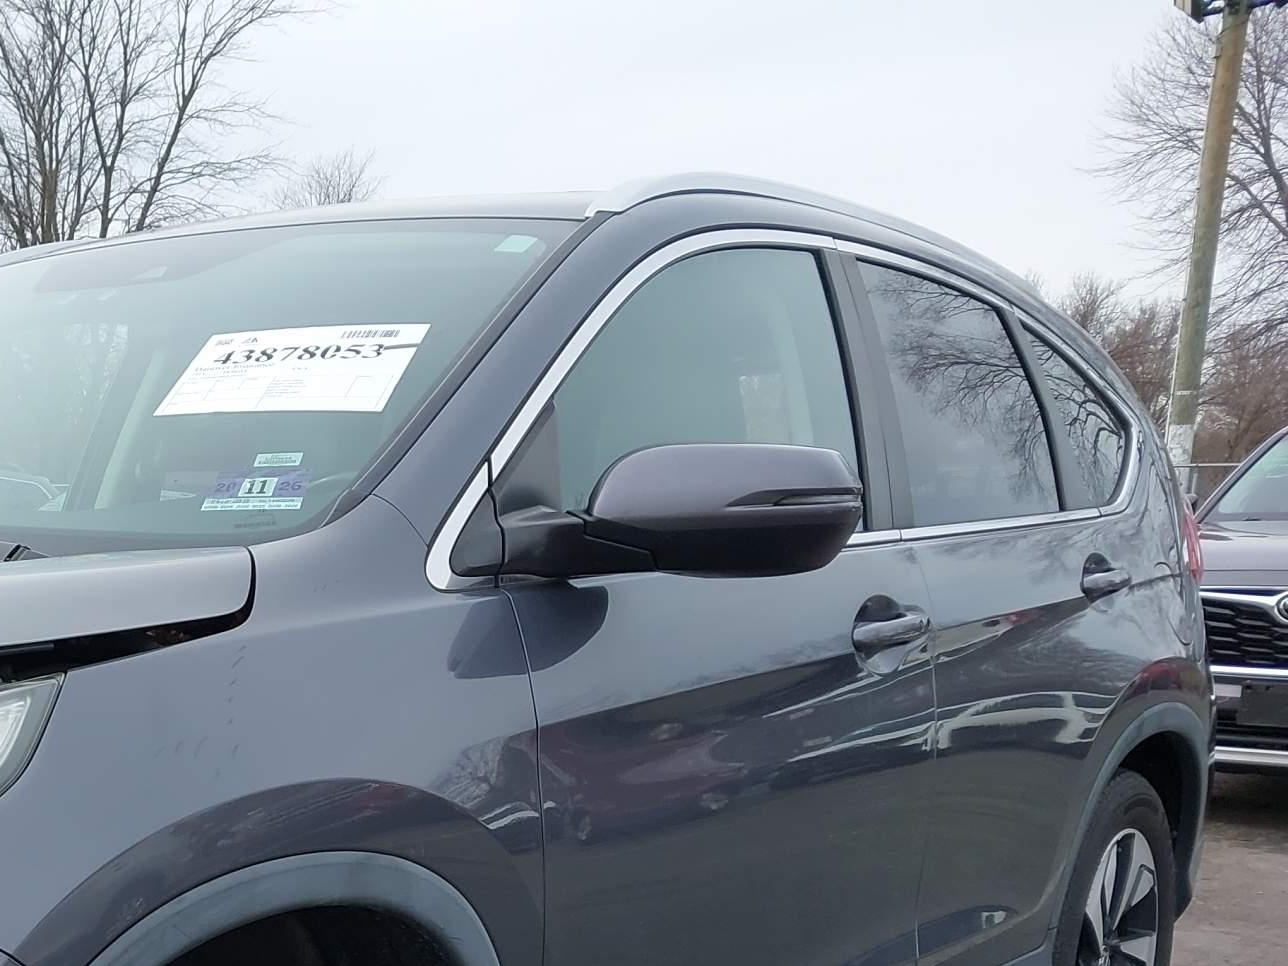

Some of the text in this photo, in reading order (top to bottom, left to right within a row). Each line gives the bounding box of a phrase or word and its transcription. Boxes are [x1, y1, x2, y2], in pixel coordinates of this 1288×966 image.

[213, 342, 384, 365] 43878053
[243, 479, 268, 495] 11
[278, 481, 302, 492] 26
